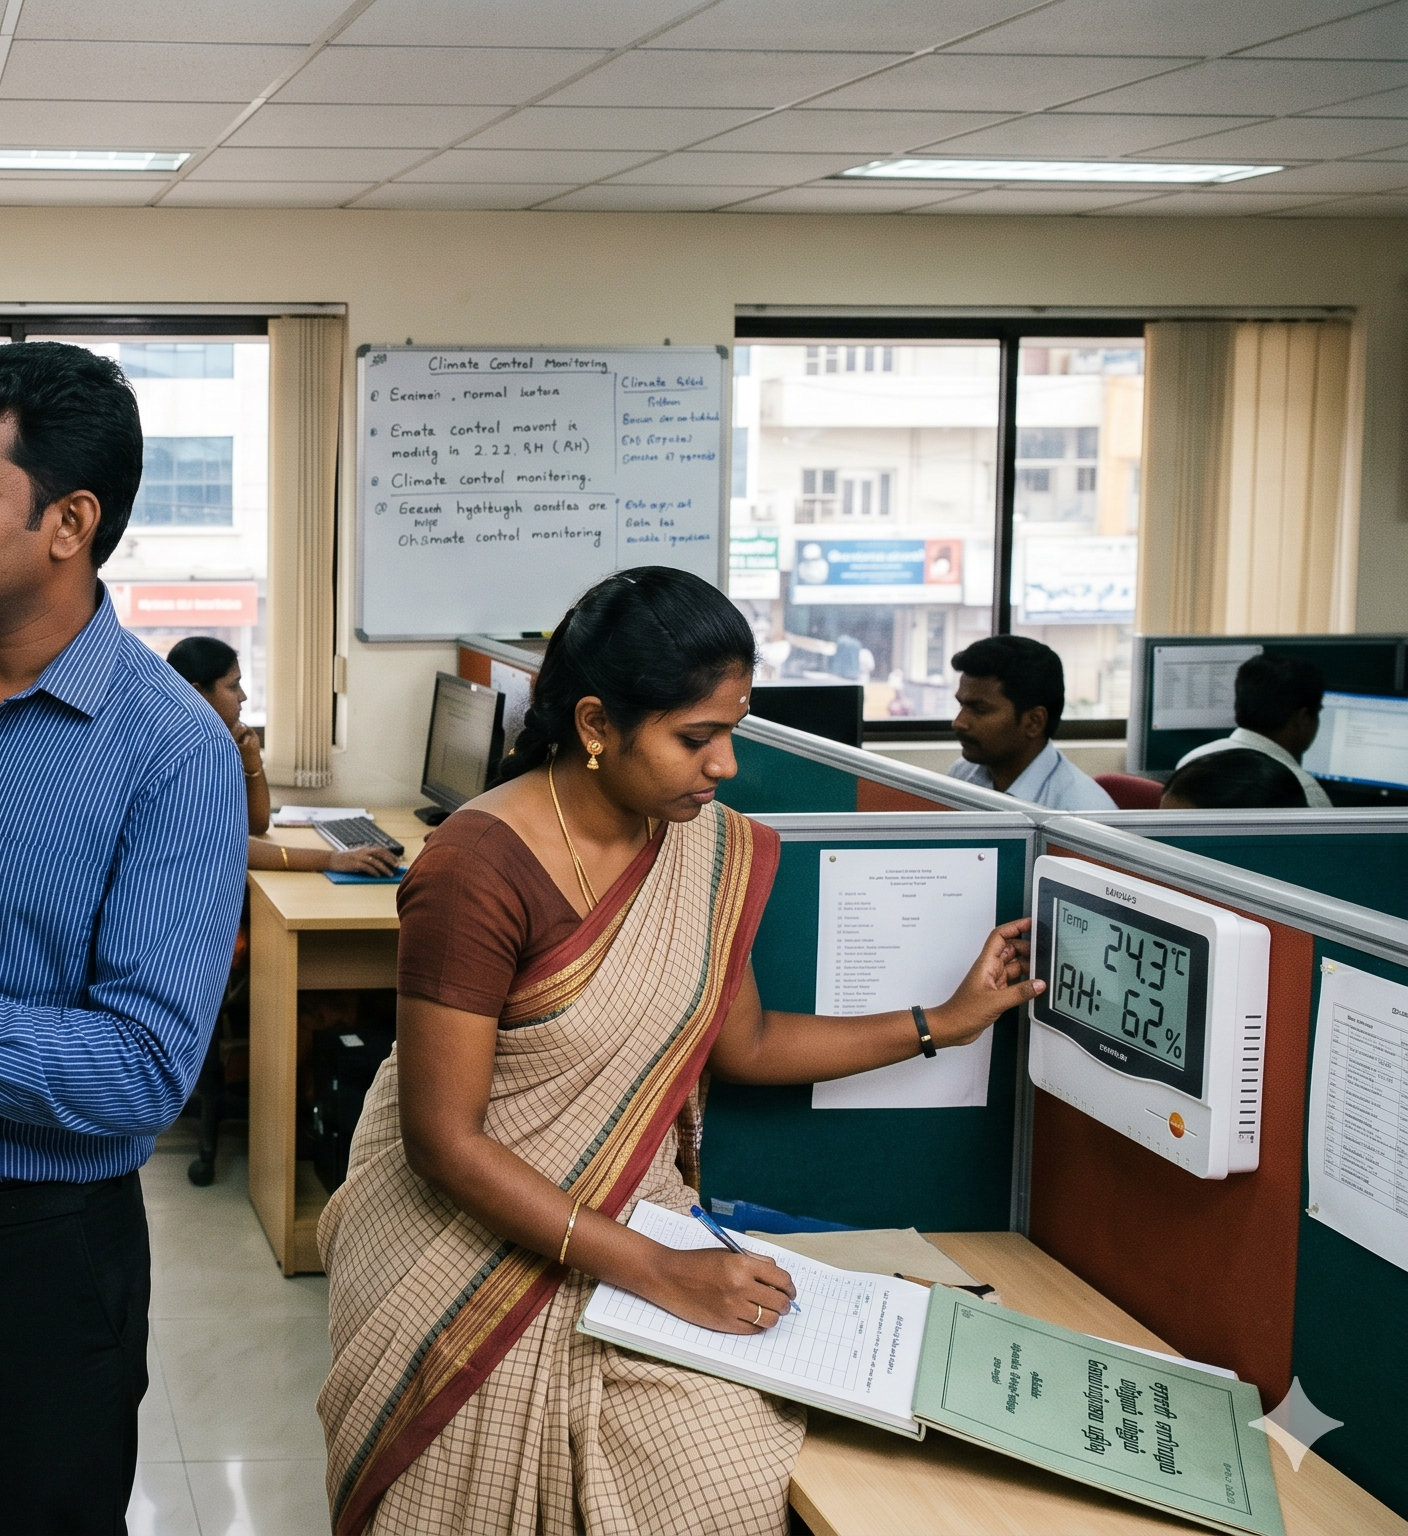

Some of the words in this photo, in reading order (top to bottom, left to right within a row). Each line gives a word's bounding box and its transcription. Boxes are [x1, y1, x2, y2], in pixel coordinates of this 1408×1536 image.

[428, 356, 479, 371] Climate
[489, 357, 533, 370] Control
[544, 357, 608, 375] Monitoring
[464, 386, 507, 400] normal
[450, 420, 500, 436] control
[391, 471, 447, 489] Climate
[459, 469, 504, 485] control
[517, 469, 592, 491] monitoring.
[475, 527, 520, 542] control
[532, 526, 602, 548] monitoring
[1062, 907, 1089, 934] Temp
